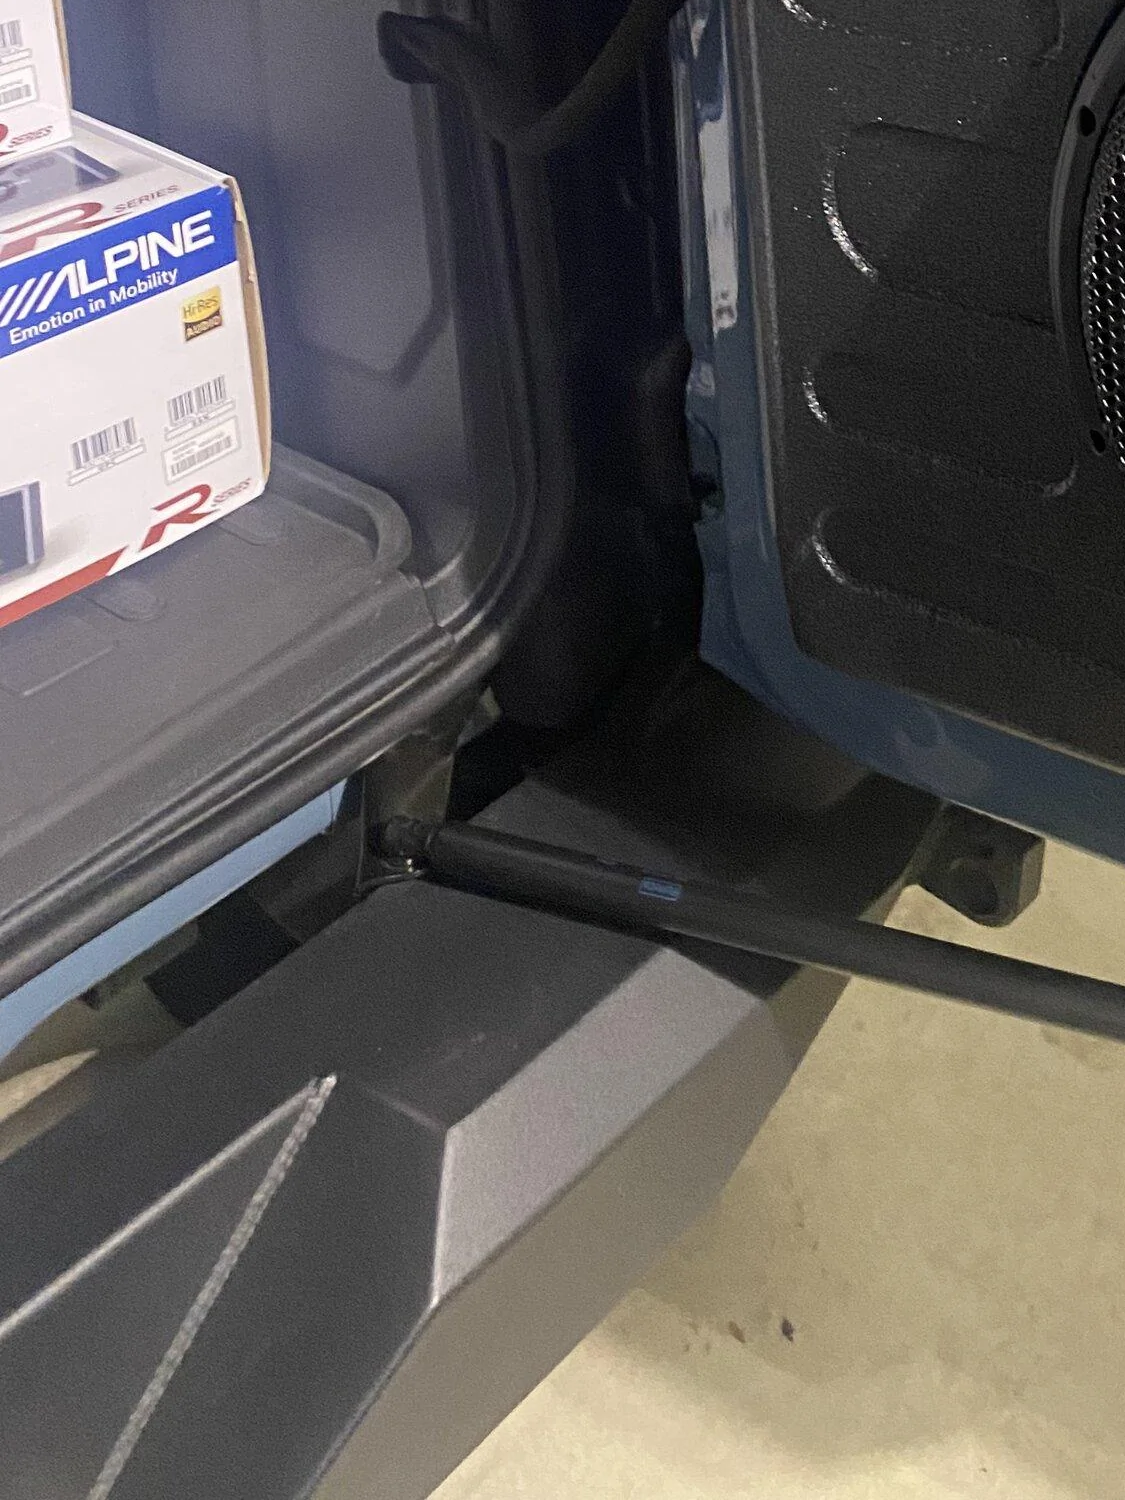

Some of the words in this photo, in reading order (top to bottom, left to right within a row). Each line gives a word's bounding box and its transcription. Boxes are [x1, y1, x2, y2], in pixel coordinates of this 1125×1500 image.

[114, 185, 180, 213] SERIES
[35, 209, 216, 313] ALPINE
[9, 306, 86, 345] Emotion
[87, 298, 107, 313] in
[109, 268, 178, 305] Mobility
[138, 483, 220, 553] R
